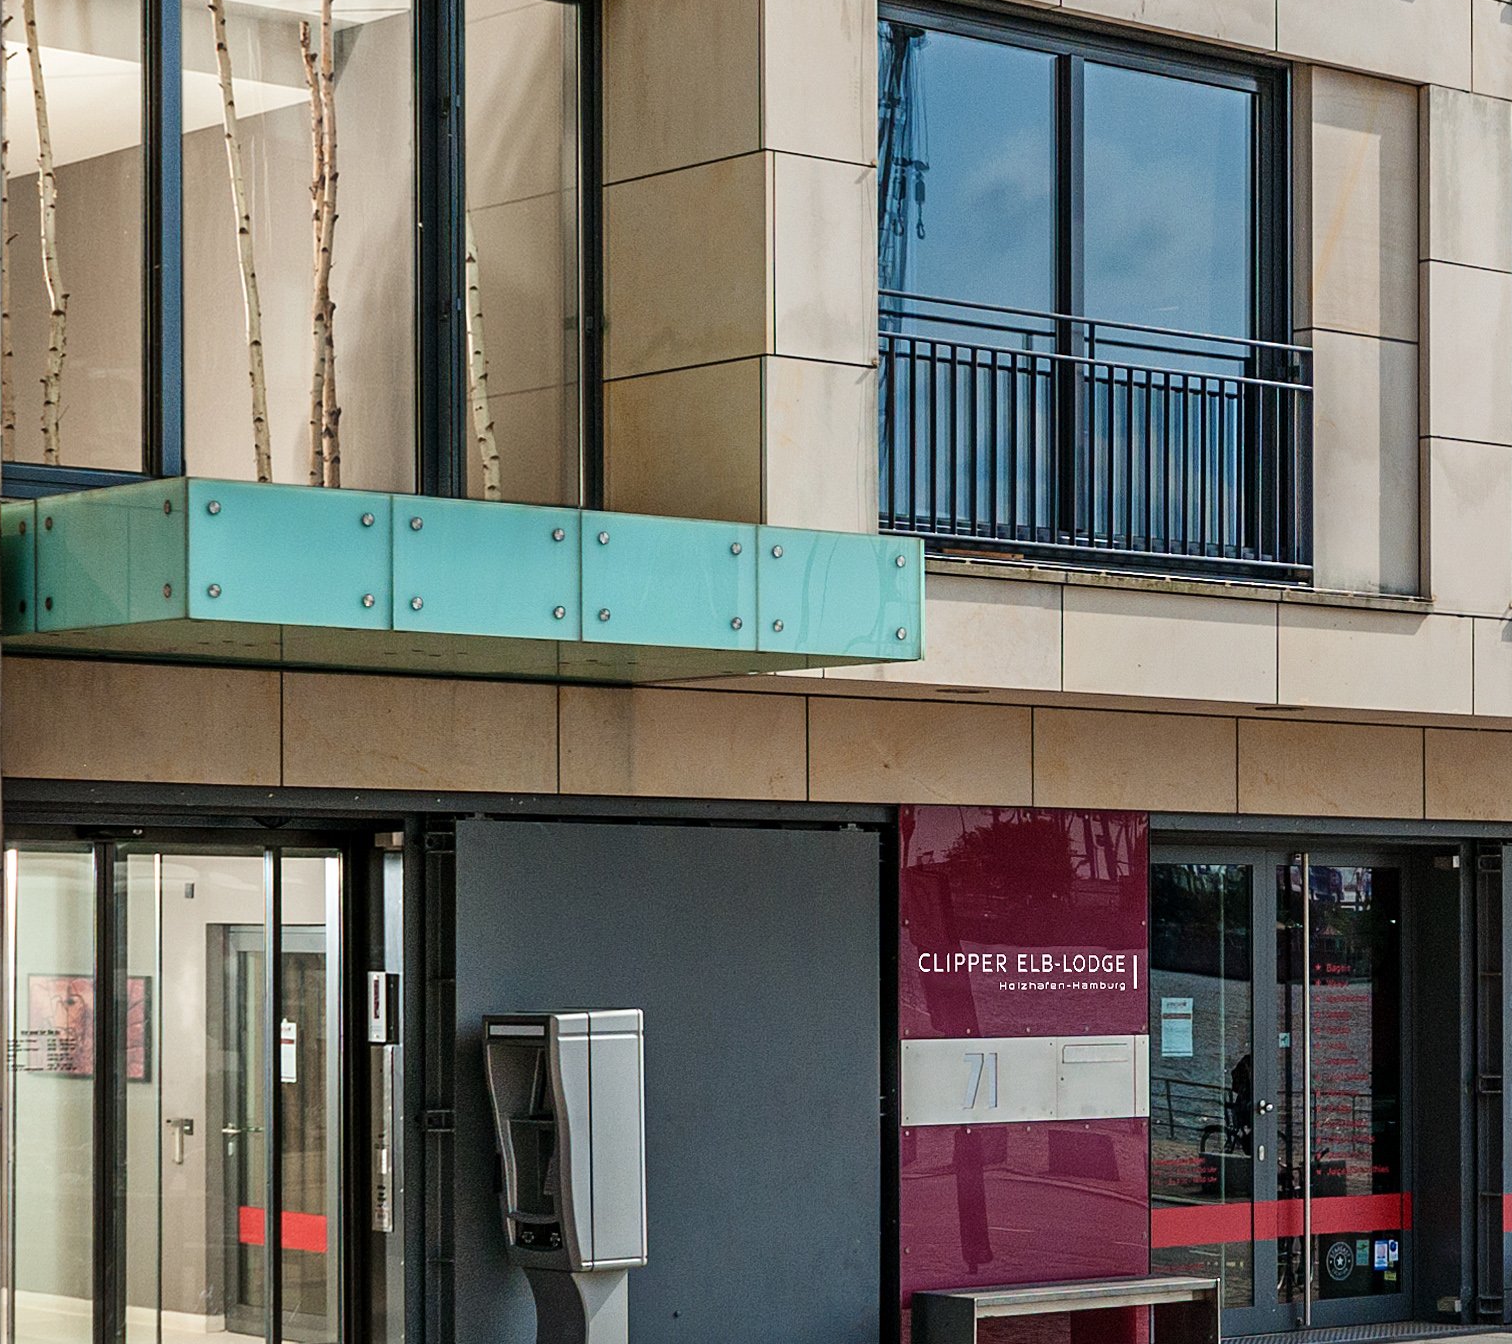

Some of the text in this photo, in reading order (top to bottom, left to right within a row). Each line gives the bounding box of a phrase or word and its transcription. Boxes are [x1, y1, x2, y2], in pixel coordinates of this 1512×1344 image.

[918, 953, 1126, 973] CLIPPER ELB-LODGE
[999, 981, 1126, 991] Holzhafen-Hamburg
[963, 1052, 998, 1110] 71
